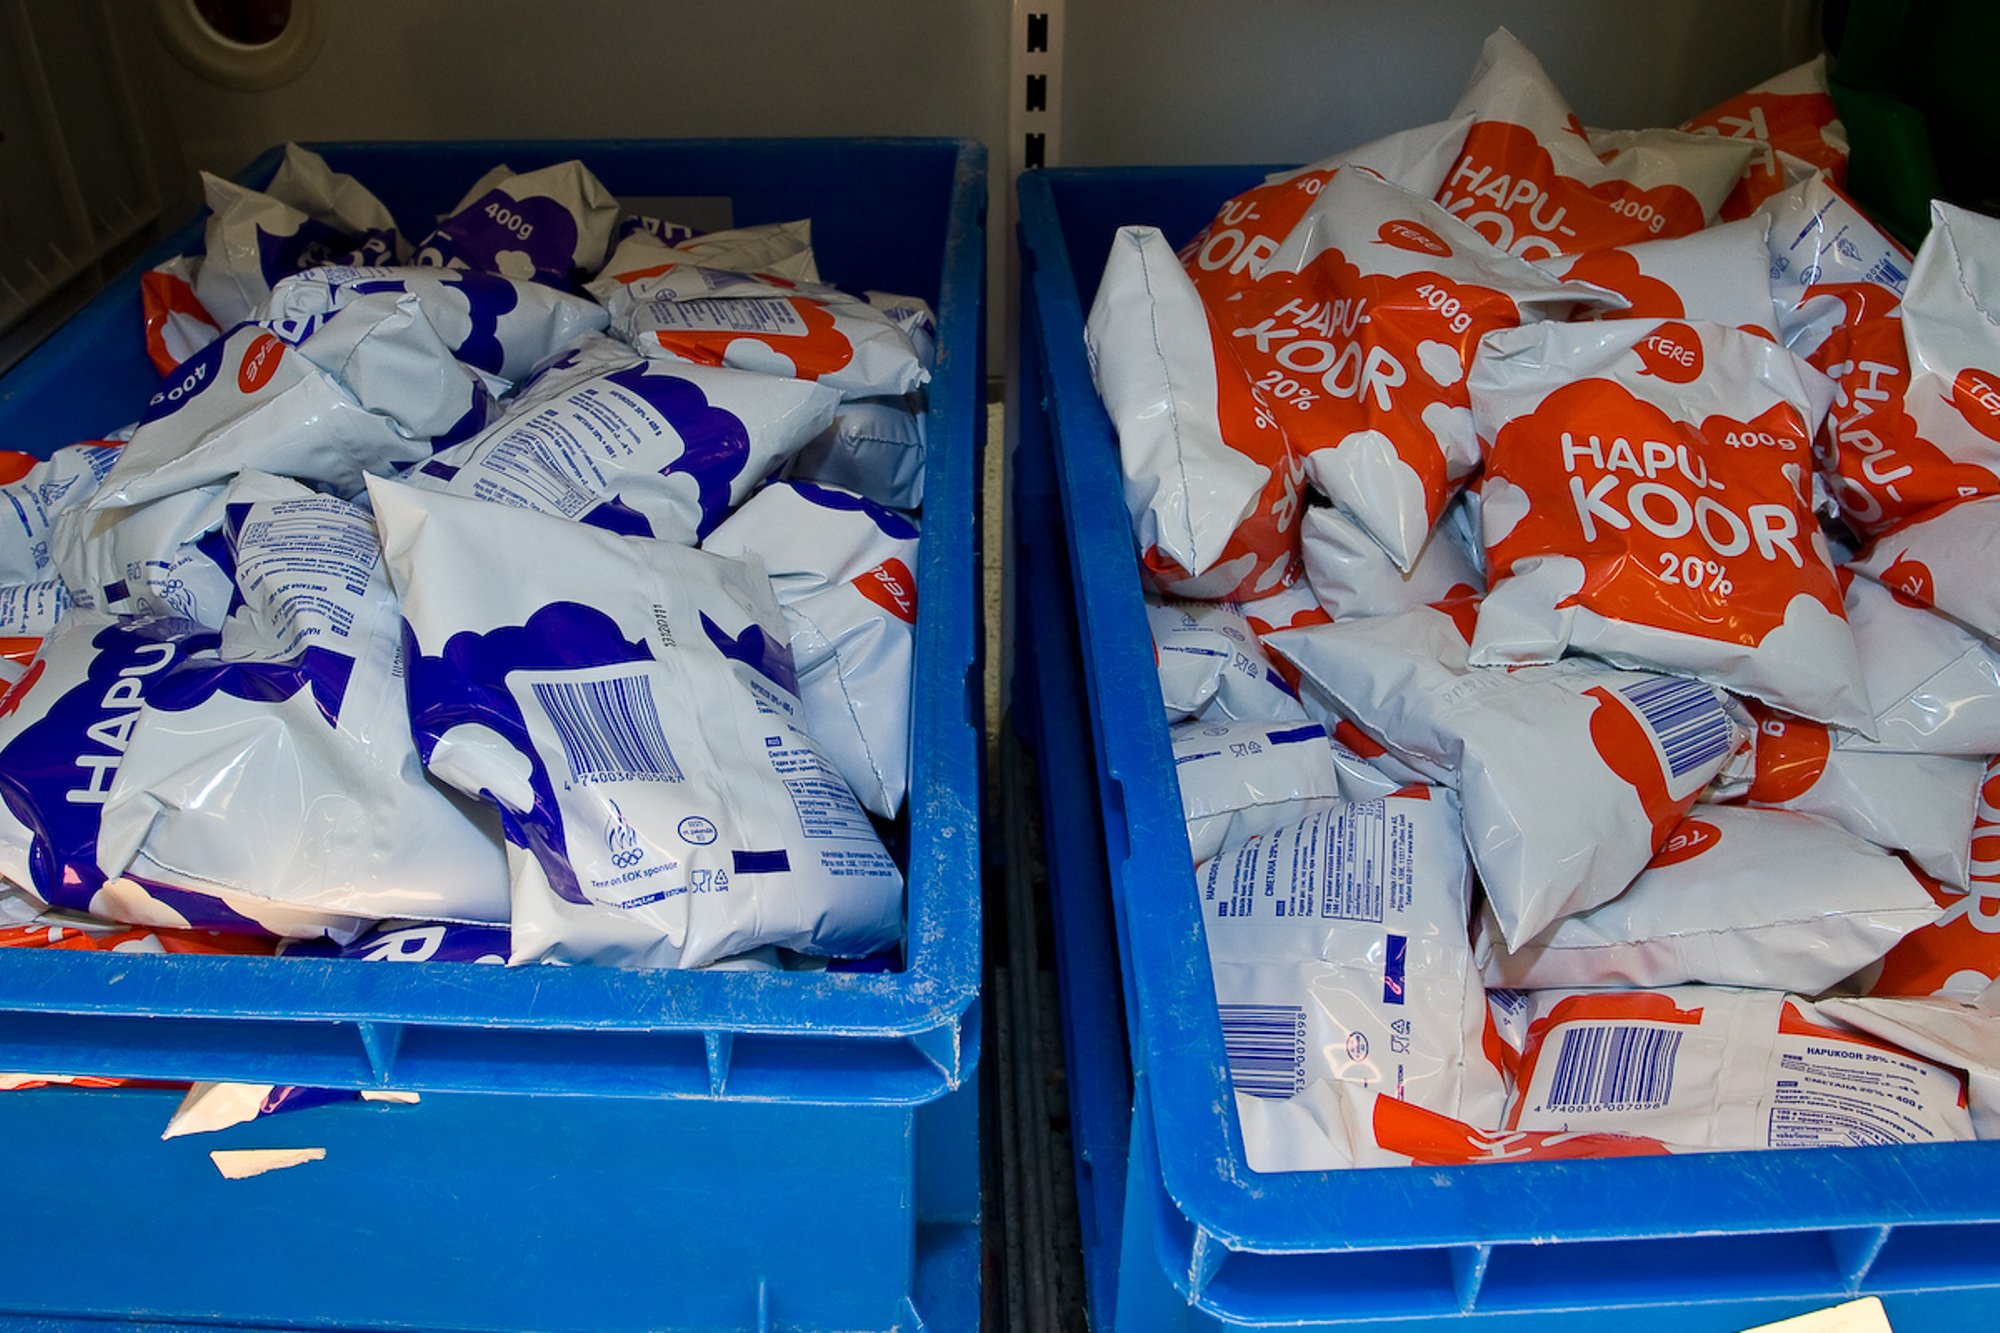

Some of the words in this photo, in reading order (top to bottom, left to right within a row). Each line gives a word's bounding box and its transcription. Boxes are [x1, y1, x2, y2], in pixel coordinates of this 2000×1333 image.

[1450, 155, 1577, 237] HAPU-
[1609, 197, 1667, 234] 400g
[484, 202, 535, 241] 400g
[1390, 222, 1445, 253] TERE
[1274, 297, 1372, 339] HAPU-
[1416, 283, 1473, 334] 400g
[1232, 318, 1407, 412] KOOR
[1644, 334, 1696, 369] TERE
[149, 362, 207, 406] 400g
[1256, 369, 1321, 411] 20%
[1723, 430, 1798, 451] 400g
[1839, 359, 1914, 503] HAPU-
[1561, 431, 1726, 491] HAPU-
[1568, 474, 1805, 569] KOOR
[1658, 551, 1735, 597] 20%
[564, 781, 571, 791] 4
[622, 871, 642, 882] EOK
[1297, 1012, 1306, 1062] 007098
[1807, 1047, 1863, 1060] HAPUKOOR
[1550, 1103, 1603, 1114] 740036
[1606, 1102, 1662, 1112] 007098
